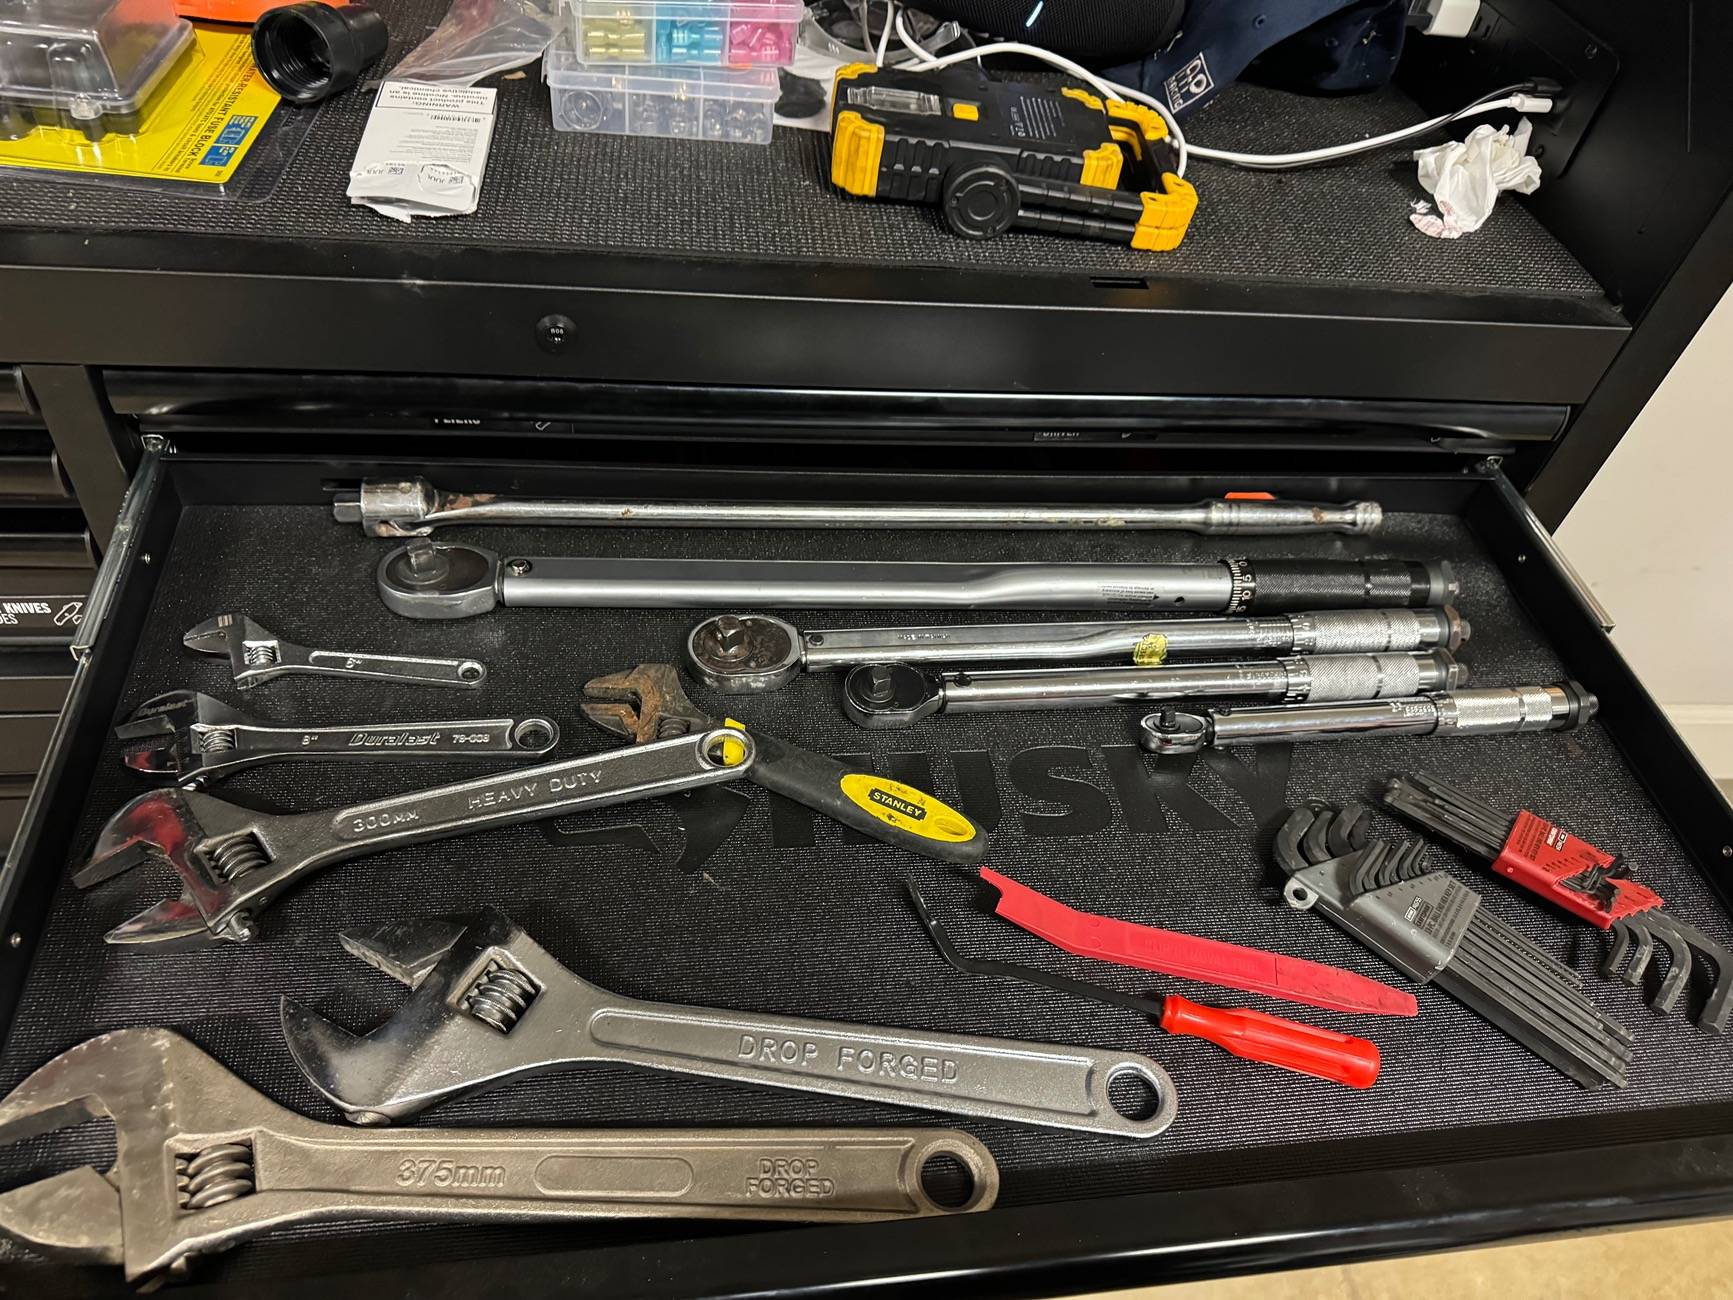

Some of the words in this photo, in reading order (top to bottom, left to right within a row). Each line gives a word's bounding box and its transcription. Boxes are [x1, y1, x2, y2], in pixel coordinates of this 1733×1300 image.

[204, 116, 224, 134] FUSE
[187, 134, 210, 157] BLOCK
[2, 602, 52, 614] KNIVES
[348, 732, 441, 746] Duralast
[468, 782, 538, 810] HEAVY
[549, 770, 603, 793] DUTY
[873, 792, 923, 817] STANLEY
[738, 1034, 819, 1067] DROP
[837, 1046, 960, 1084] FORGED
[395, 1158, 507, 1188] 375mm
[758, 1157, 820, 1177] DROP
[745, 1176, 835, 1198] FORGED
